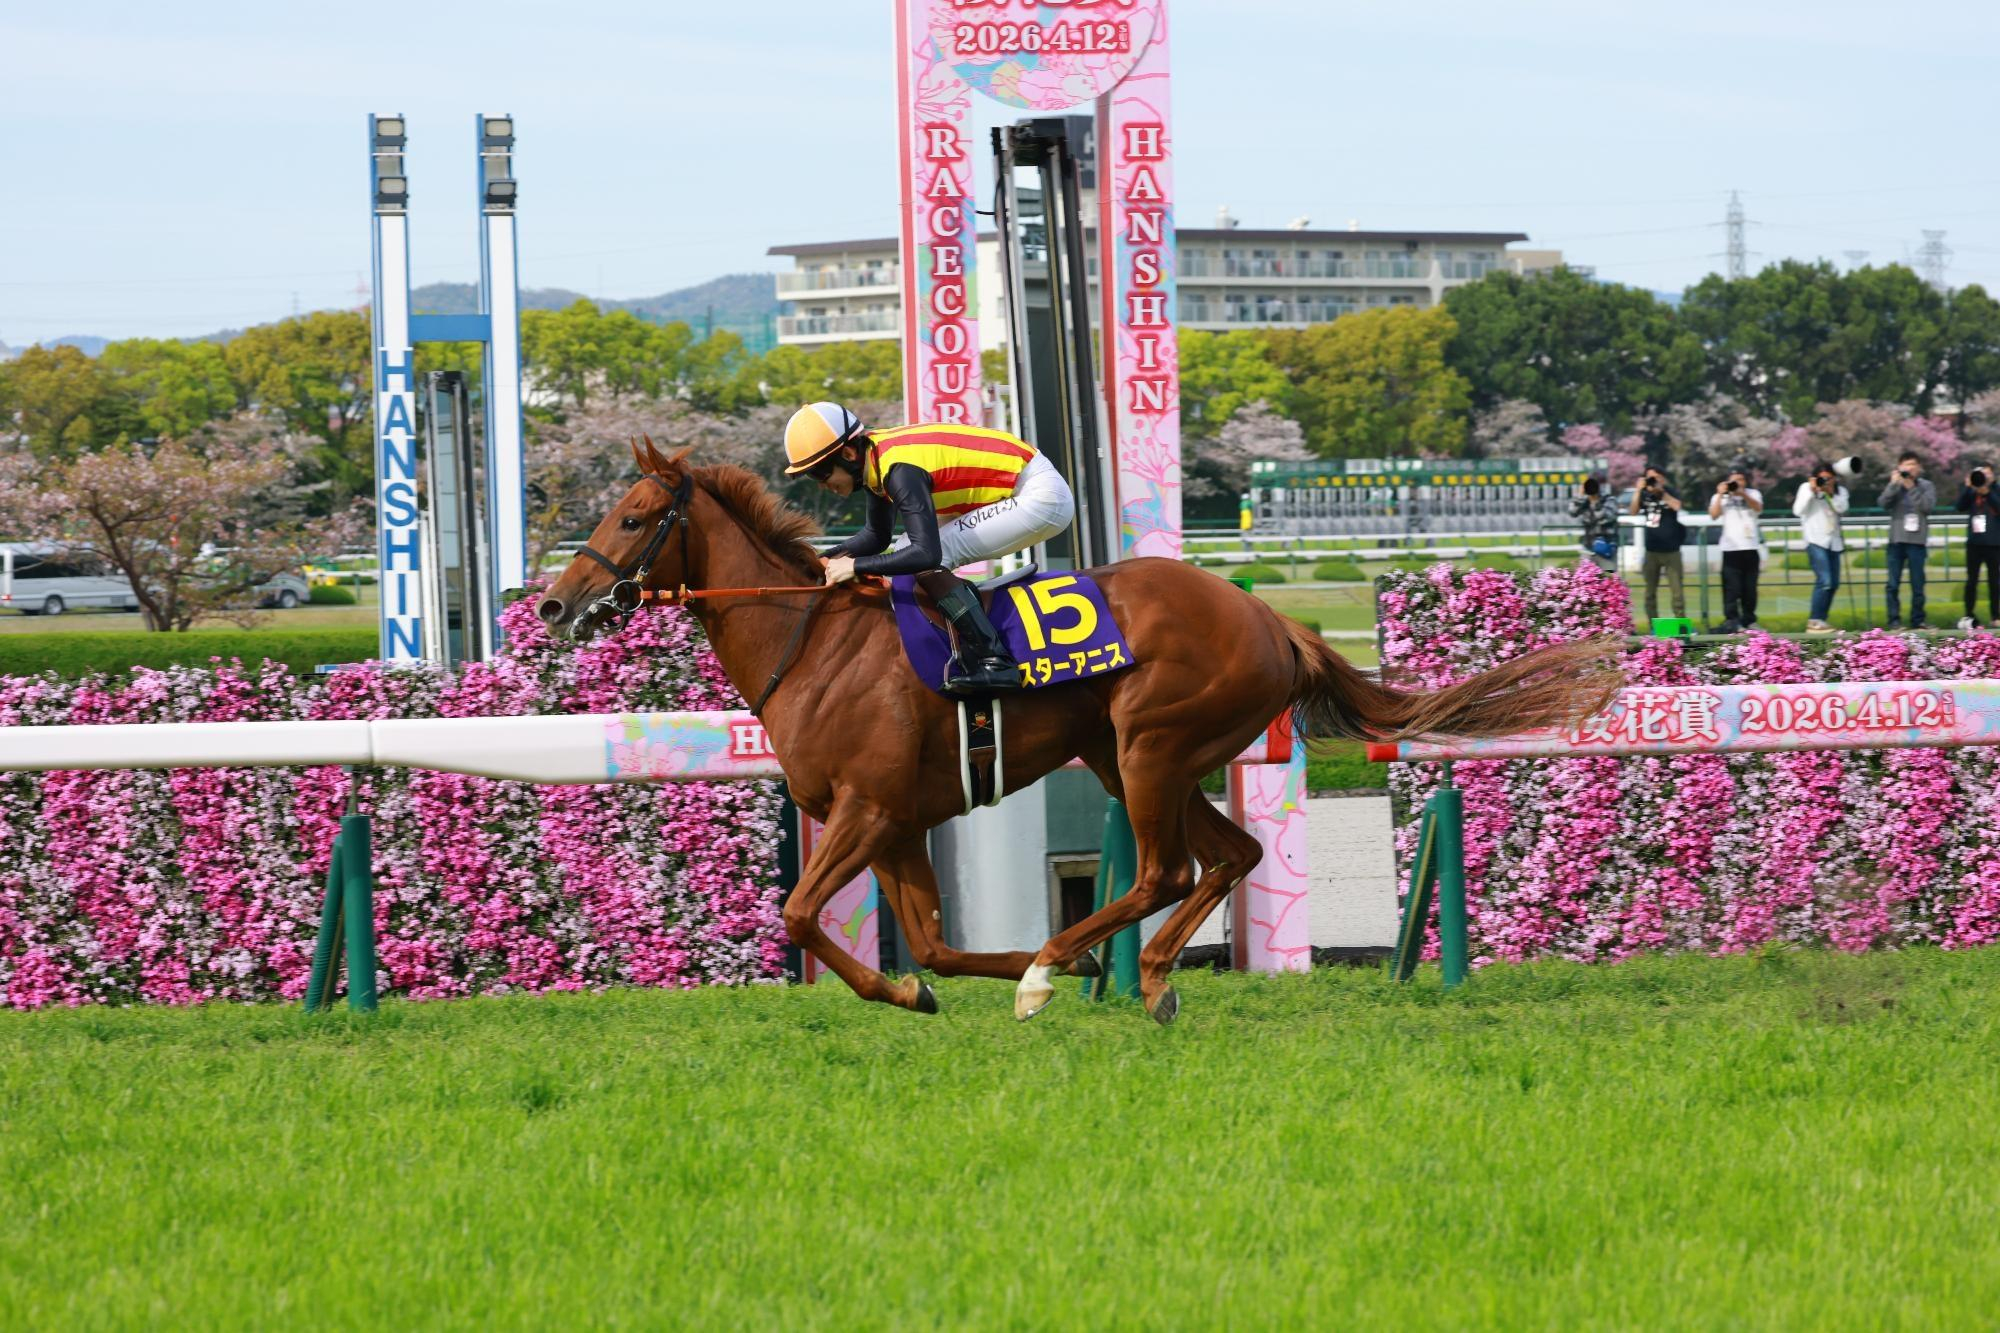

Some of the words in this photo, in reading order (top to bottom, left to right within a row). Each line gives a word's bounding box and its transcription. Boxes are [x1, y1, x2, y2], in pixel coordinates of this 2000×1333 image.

[956, 24, 1116, 51] 2026.4.12
[927, 128, 968, 424] RACECOUR
[1126, 126, 1166, 410] HANSHIN
[380, 350, 420, 658] HANSHIN
[1007, 575, 1098, 651] 15
[1018, 642, 1126, 688] スターアニス
[1740, 692, 1941, 731] 2026.4.12
